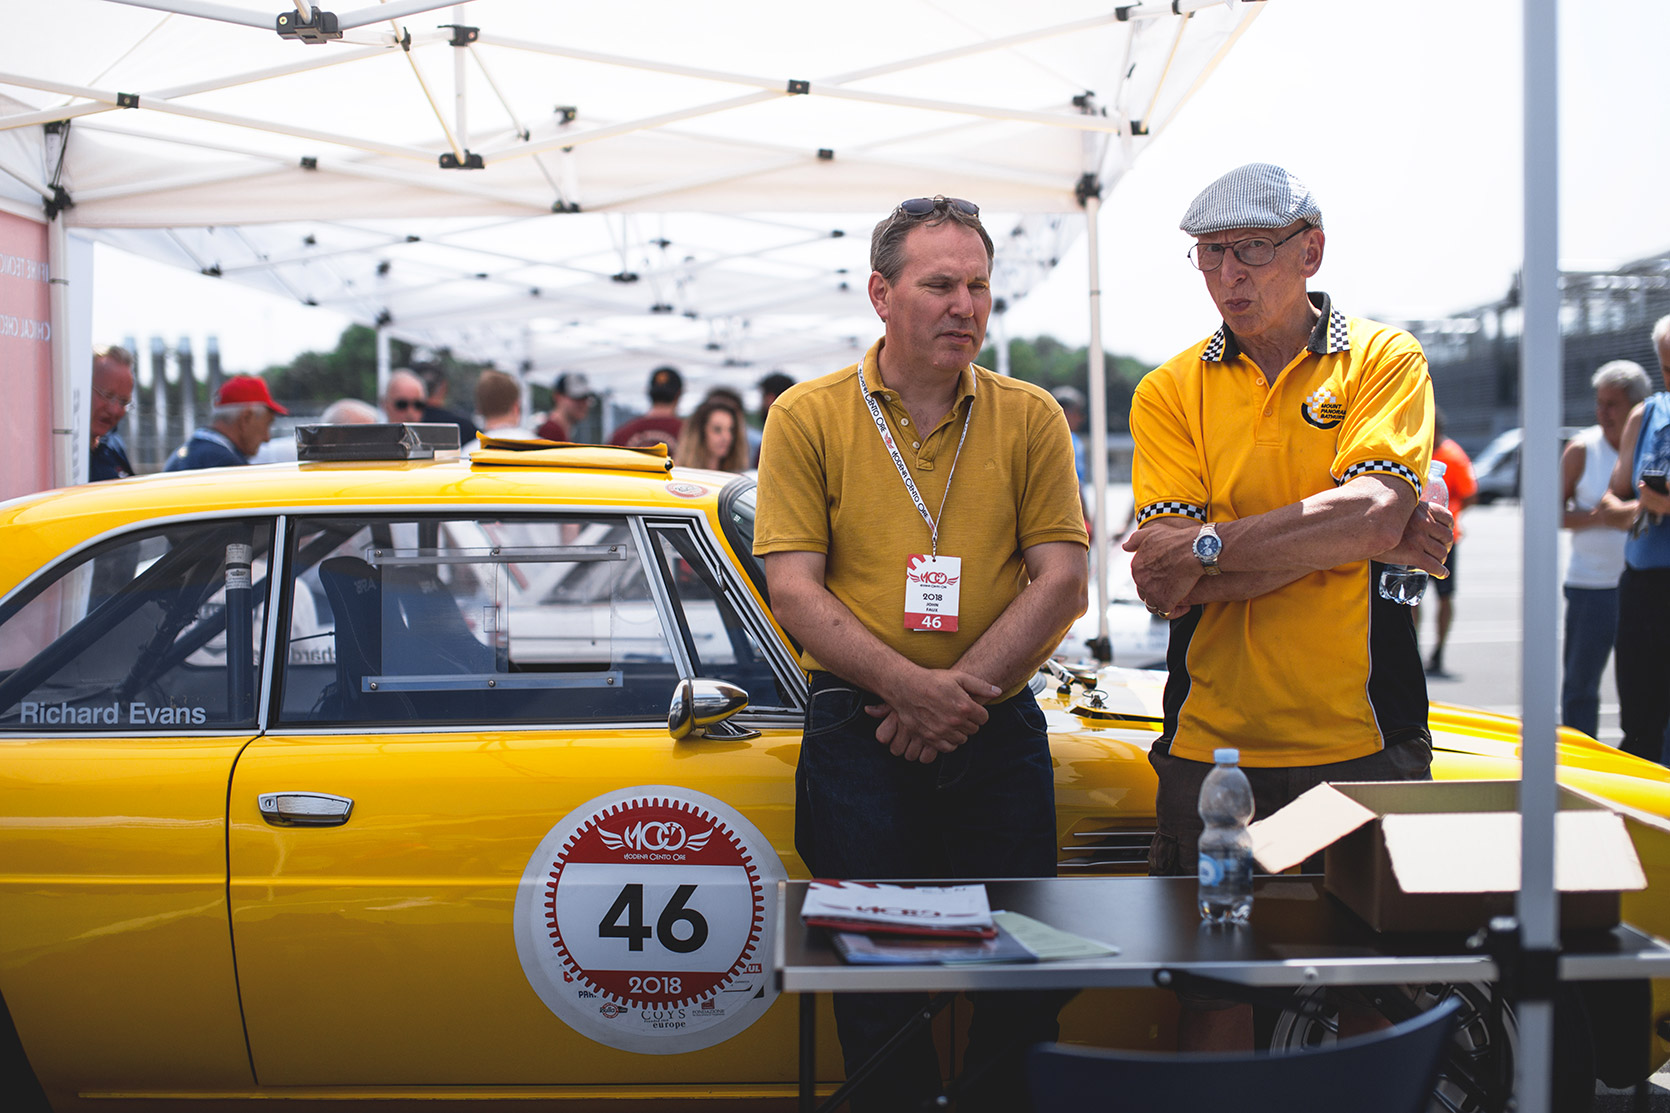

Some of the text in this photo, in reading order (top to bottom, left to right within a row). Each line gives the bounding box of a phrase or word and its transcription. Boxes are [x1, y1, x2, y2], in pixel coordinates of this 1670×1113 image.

[875, 417, 887, 432] ORE
[905, 477, 920, 503] CENTO
[922, 593, 943, 602] 2018
[921, 615, 942, 629] 46
[20, 702, 206, 724] Richard Evans
[649, 853, 671, 861] CENTO
[672, 853, 687, 861] ORE
[599, 883, 709, 953] 46
[628, 976, 682, 995] 2018
[652, 1020, 686, 1029] europe
